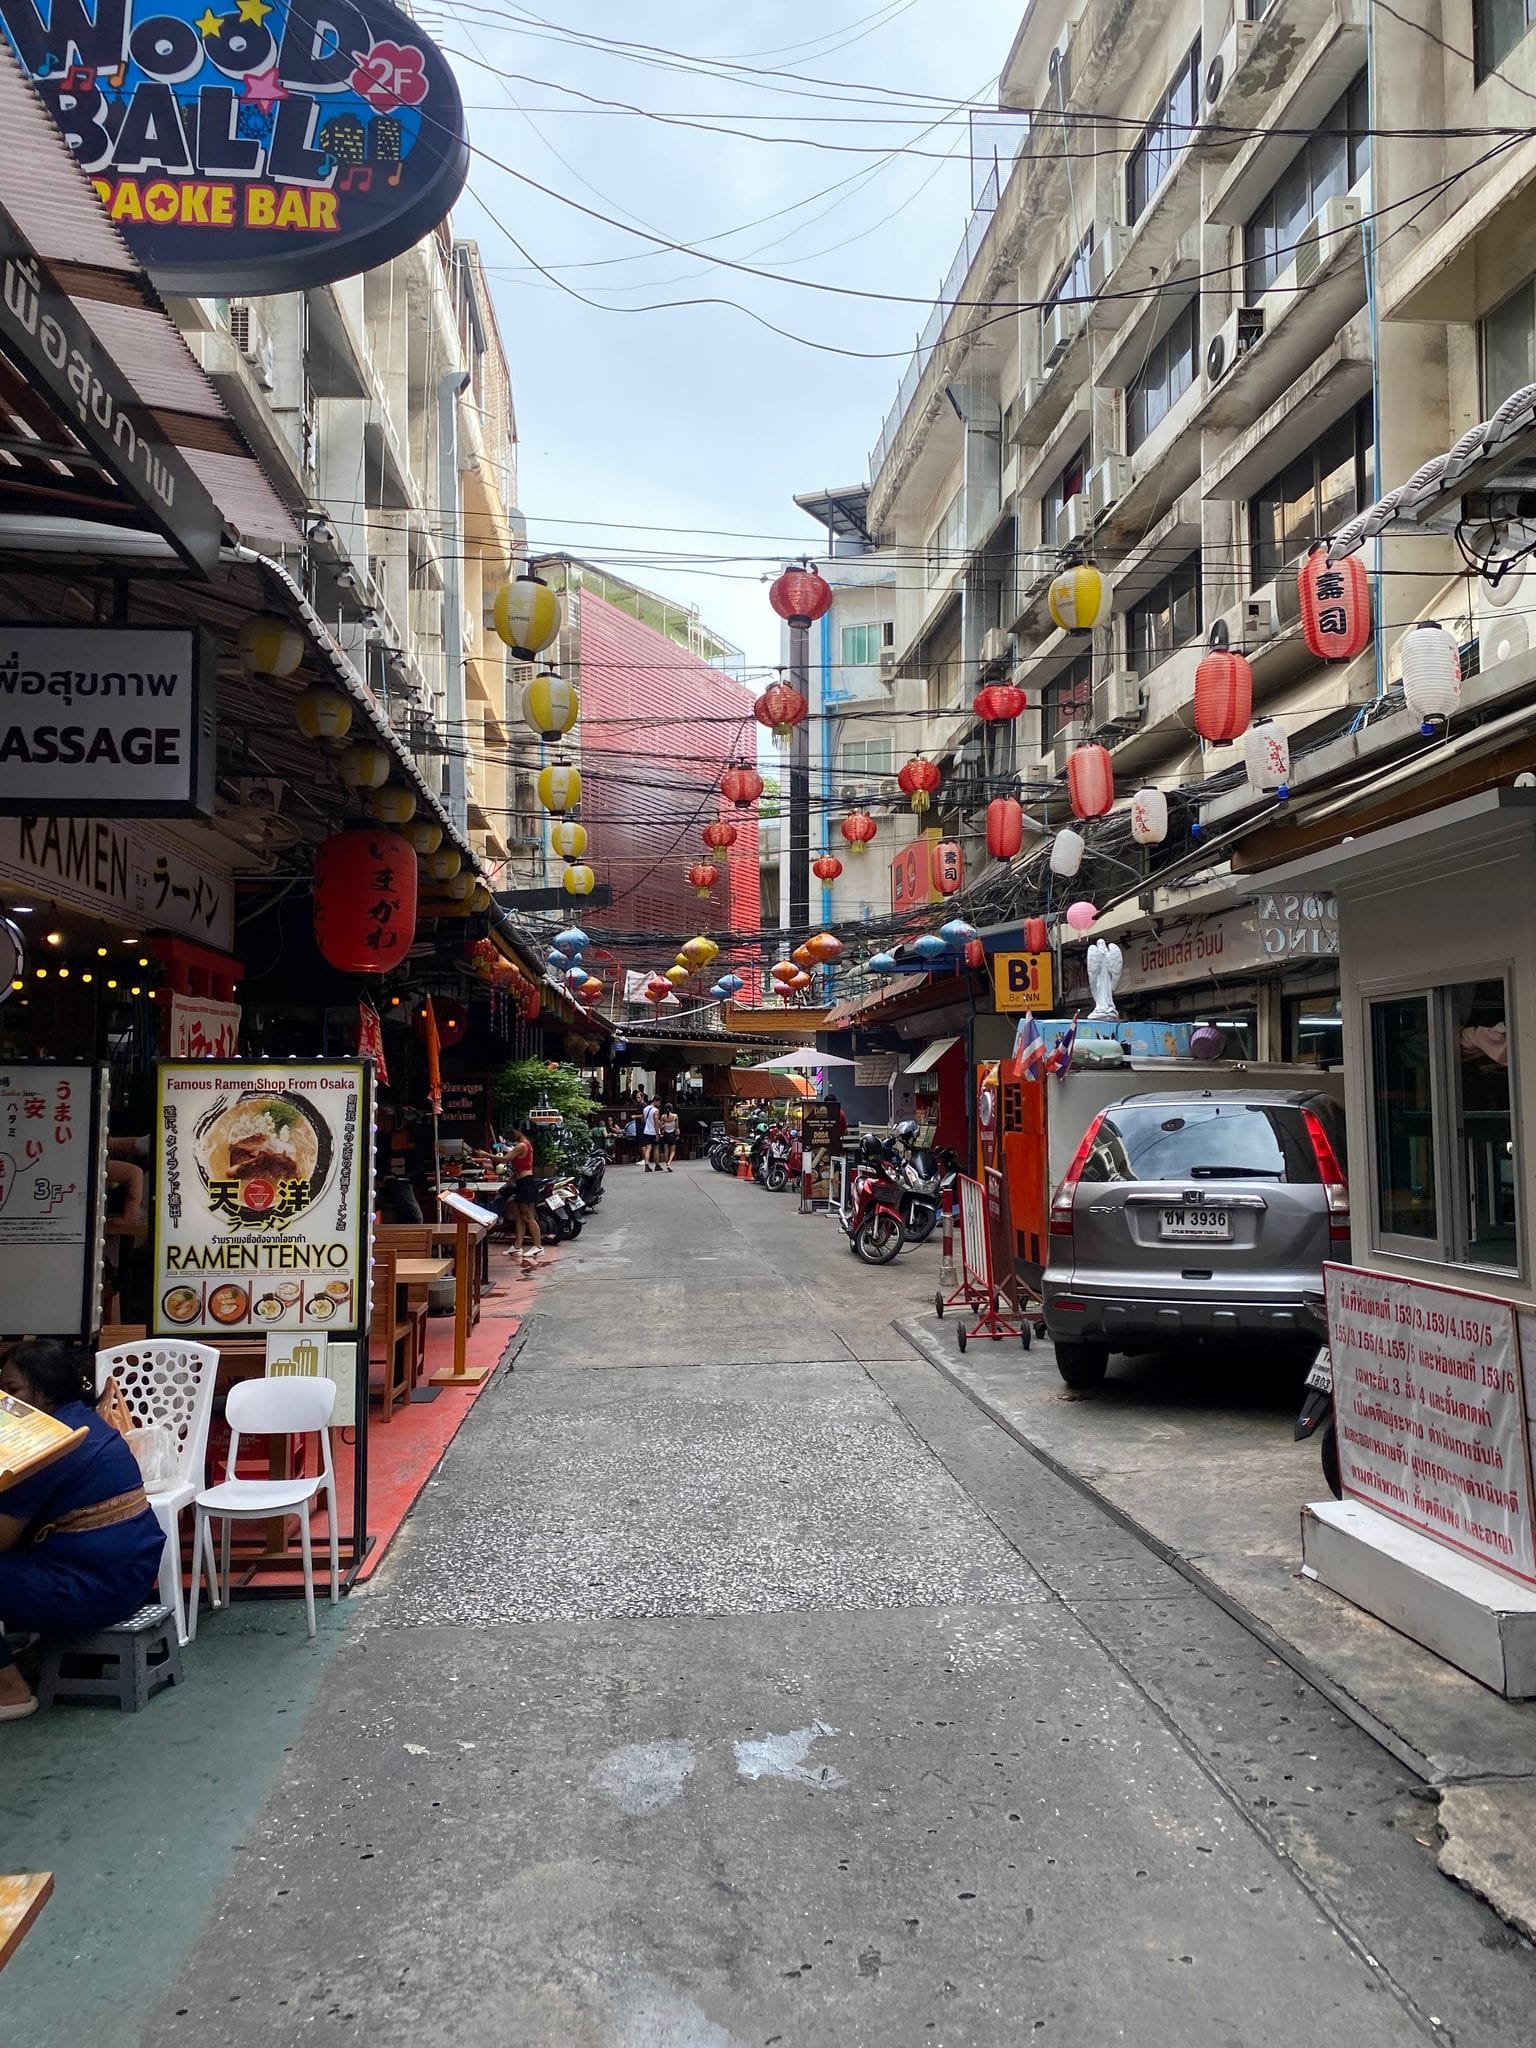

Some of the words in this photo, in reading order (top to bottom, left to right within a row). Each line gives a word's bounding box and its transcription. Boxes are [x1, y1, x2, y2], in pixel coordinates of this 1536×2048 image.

[369, 57, 412, 96] 2F
[42, 82, 338, 188] BALL
[247, 184, 340, 231] BAR
[0, 726, 180, 765] ASSAGE
[20, 817, 128, 900] RAMEN
[153, 857, 220, 929] ラーメン
[1008, 958, 1039, 992] Bi
[167, 1078, 212, 1091] Famous
[214, 1078, 256, 1091] Ramen
[256, 1077, 286, 1093] Shop
[288, 1077, 317, 1090] From
[320, 1077, 355, 1090] Osaka
[54, 1080, 73, 1144] うまい
[34, 1179, 62, 1201] 3F
[208, 1180, 240, 1212] 天
[276, 1180, 310, 1212] 洋
[227, 1217, 292, 1234] ラーメン
[1190, 1212, 1226, 1226] 3936
[167, 1244, 258, 1269] RAMEN
[262, 1243, 349, 1269] TENYO
[1311, 1373, 1331, 1390] 1803
[1392, 1377, 1400, 1396] 3
[1419, 1386, 1426, 1405] 4
[1481, 1365, 1515, 1395] 153/6
